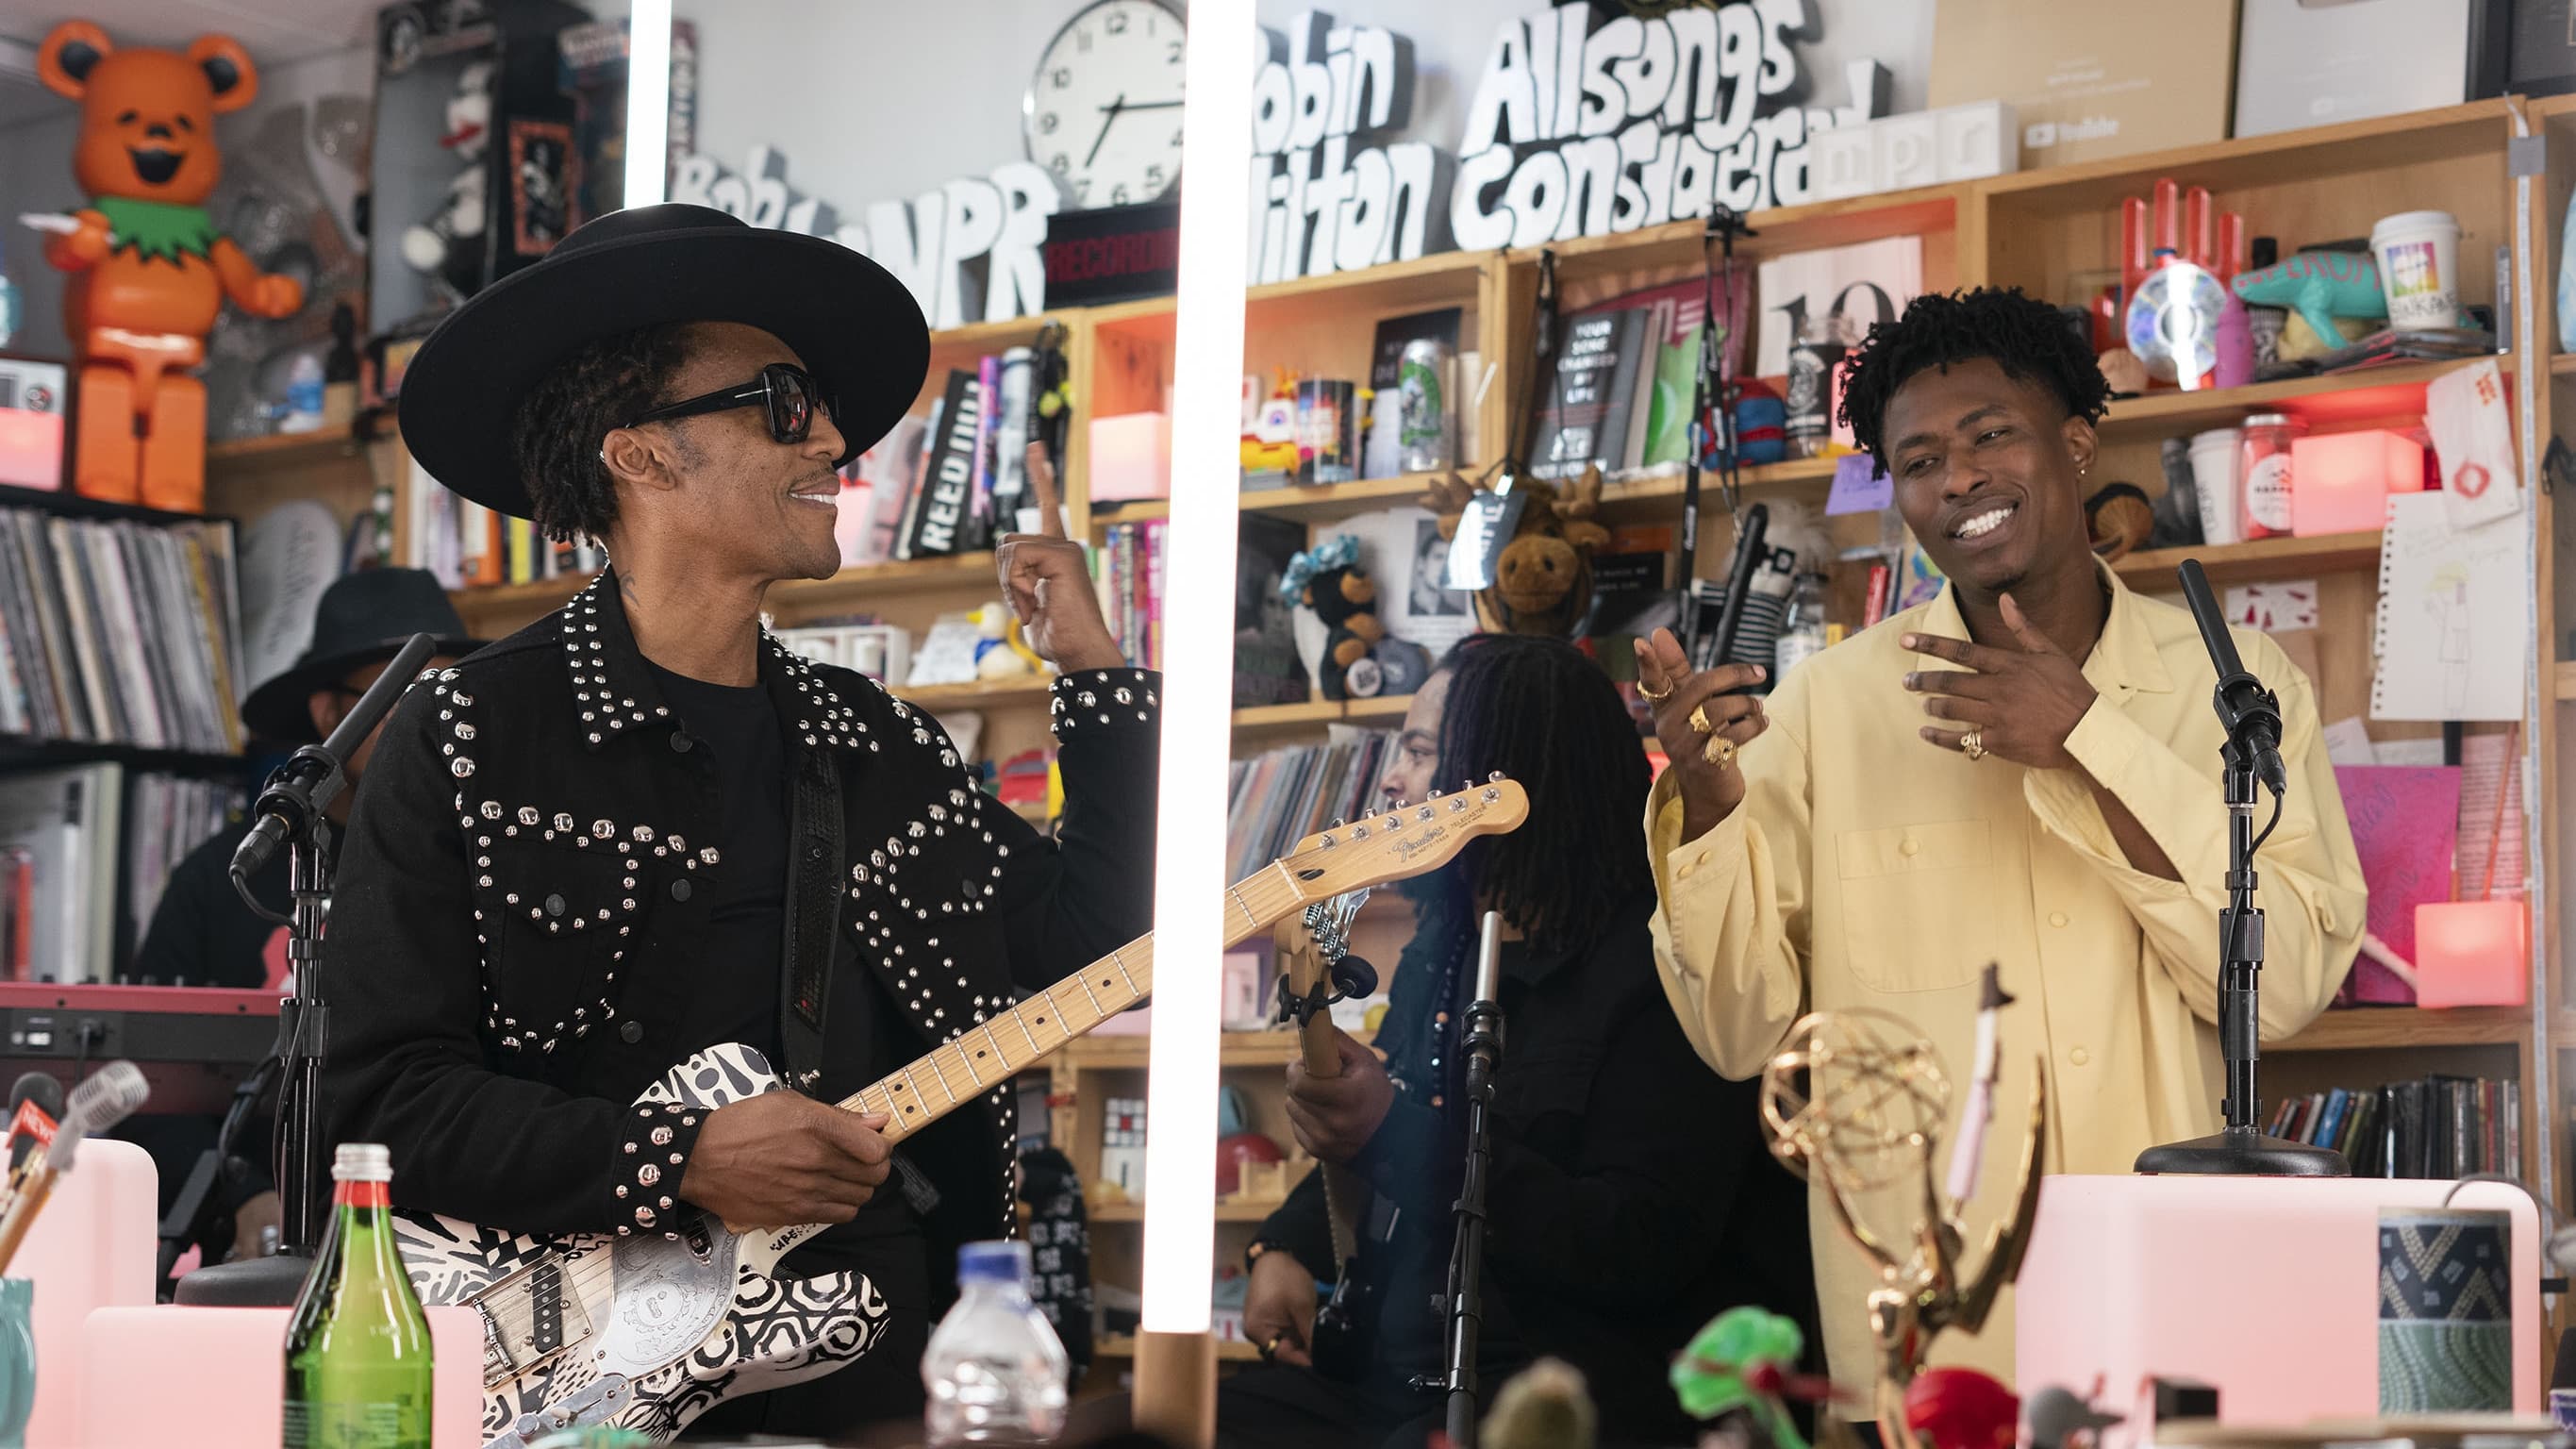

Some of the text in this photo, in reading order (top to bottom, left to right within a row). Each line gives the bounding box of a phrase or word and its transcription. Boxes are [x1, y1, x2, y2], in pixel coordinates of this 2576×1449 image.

[1106, 12, 1127, 35] 12
[1169, 42, 1182, 63] 2
[1053, 68, 1071, 89] 10
[1255, 9, 1395, 154] obin
[1041, 111, 1058, 134] 9
[1146, 165, 1163, 188] 5
[1077, 178, 1092, 202] 7
[1112, 183, 1128, 205] 6
[866, 161, 1057, 331] NPR
[920, 457, 971, 552] REED
[1392, 825, 1445, 862] Fender
